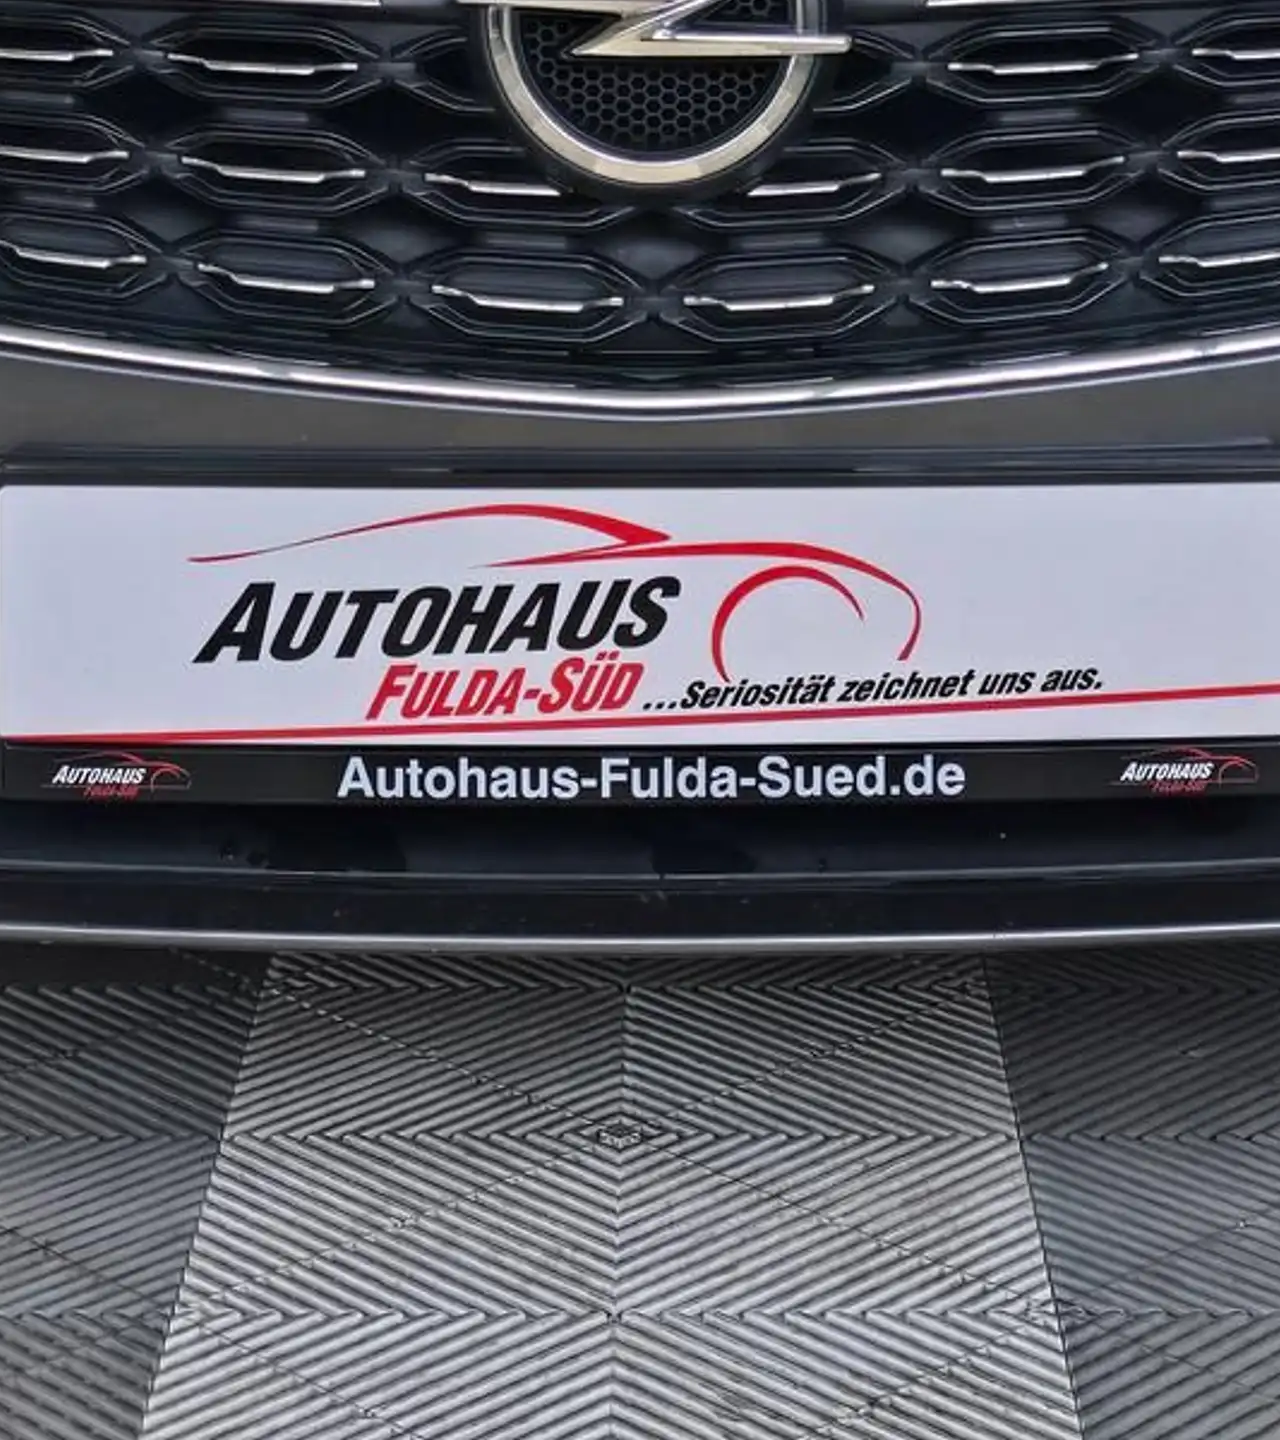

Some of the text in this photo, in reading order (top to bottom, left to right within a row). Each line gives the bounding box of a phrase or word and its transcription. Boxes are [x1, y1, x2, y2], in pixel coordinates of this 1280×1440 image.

[192, 575, 682, 664] AUTOHAUS
[365, 650, 644, 721] FULDA-SÜD
[642, 665, 1103, 711] ...Seriosität zeichnet uns aus.
[52, 765, 147, 785] AUTOHAUS
[336, 753, 966, 800] Autohaus-Fulda-Sued.de
[1120, 761, 1214, 782] AUTOHAUS
